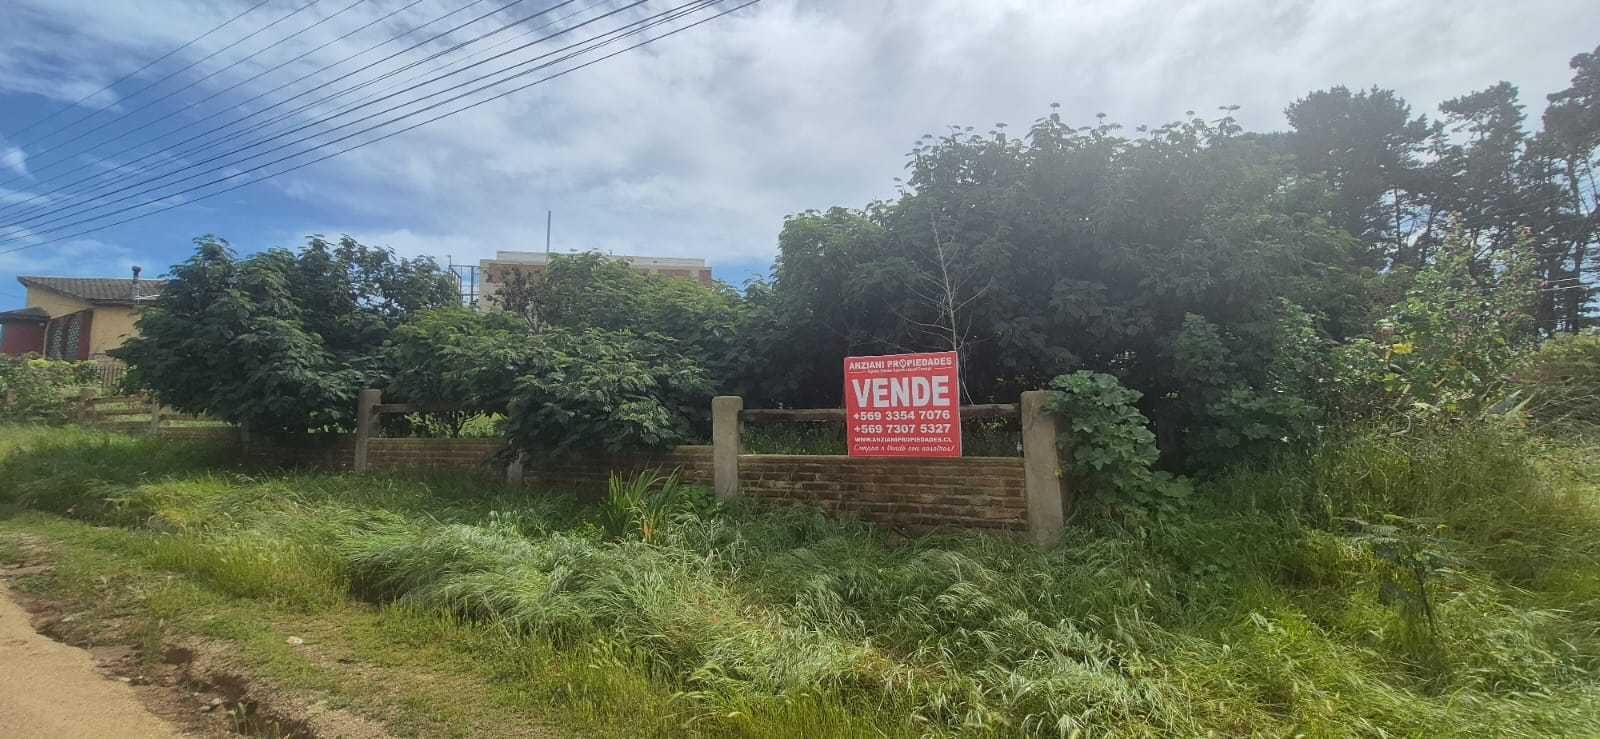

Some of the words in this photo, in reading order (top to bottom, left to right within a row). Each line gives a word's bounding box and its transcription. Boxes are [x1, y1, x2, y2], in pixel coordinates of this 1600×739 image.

[849, 359, 884, 370] ANZIANI
[887, 357, 952, 368] PROPIEDADES
[852, 375, 951, 408] VENDE
[853, 411, 881, 420] +569
[886, 410, 915, 420] 3354
[919, 409, 951, 420] 7076
[854, 424, 883, 434] +569
[887, 424, 915, 434] 7307
[920, 423, 952, 434] 5327
